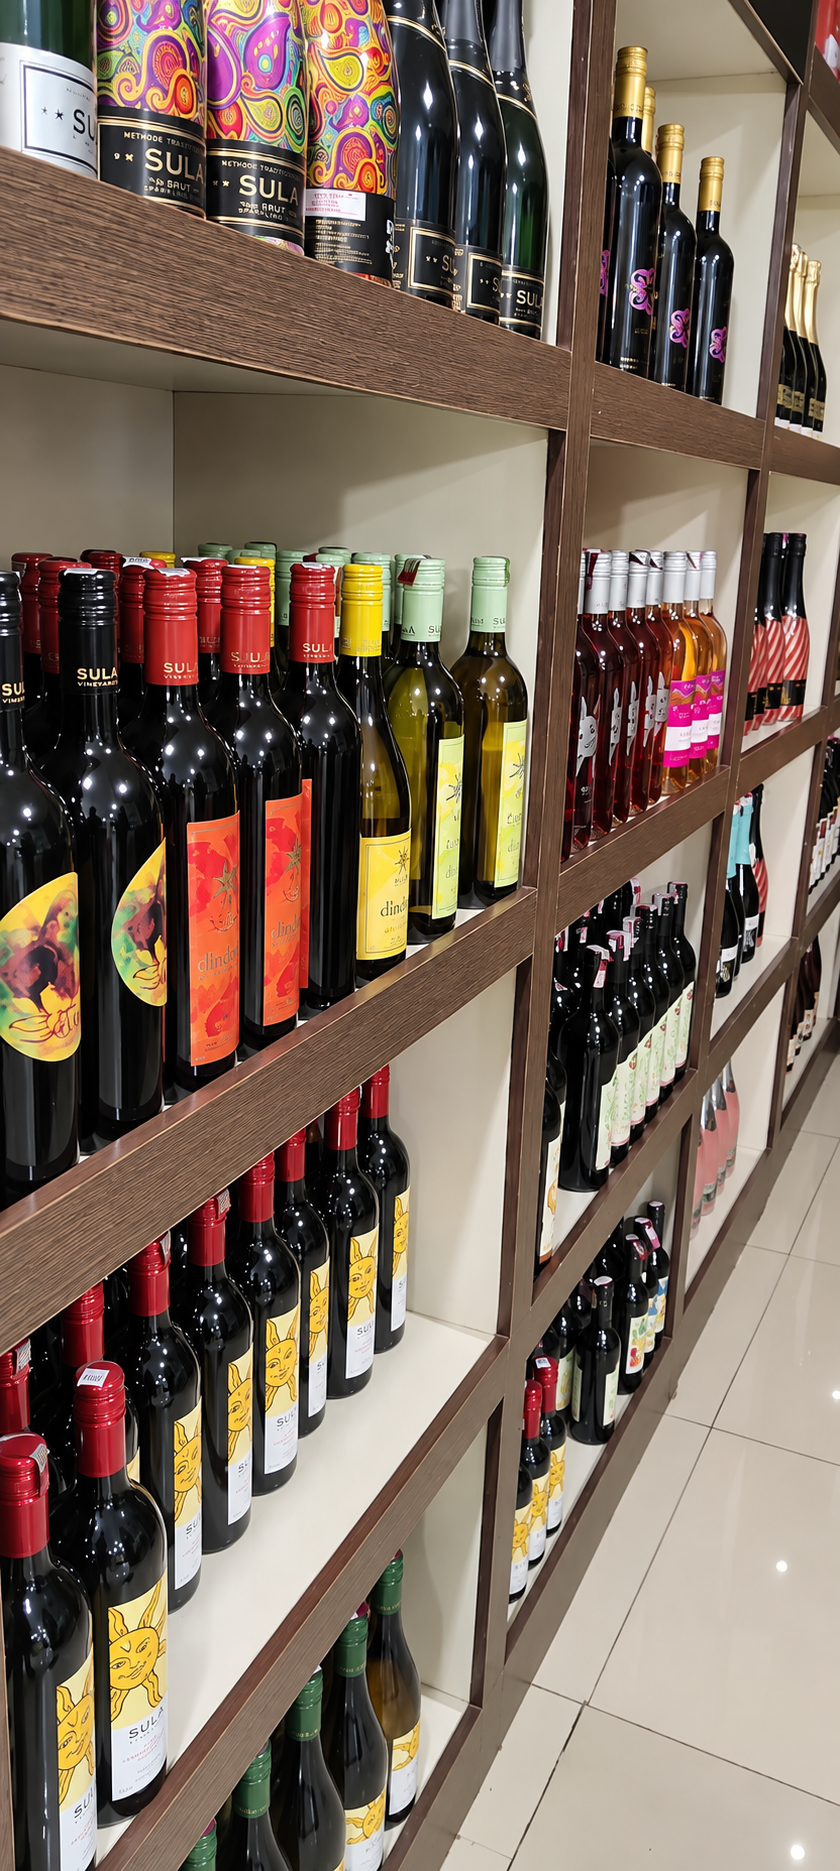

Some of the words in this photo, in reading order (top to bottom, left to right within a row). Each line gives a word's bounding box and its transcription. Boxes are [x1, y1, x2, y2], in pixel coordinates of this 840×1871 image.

[144, 147, 204, 185] SULA
[239, 174, 299, 207] SULA
[76, 666, 118, 681] SULA
[128, 1706, 164, 1740] SULA
